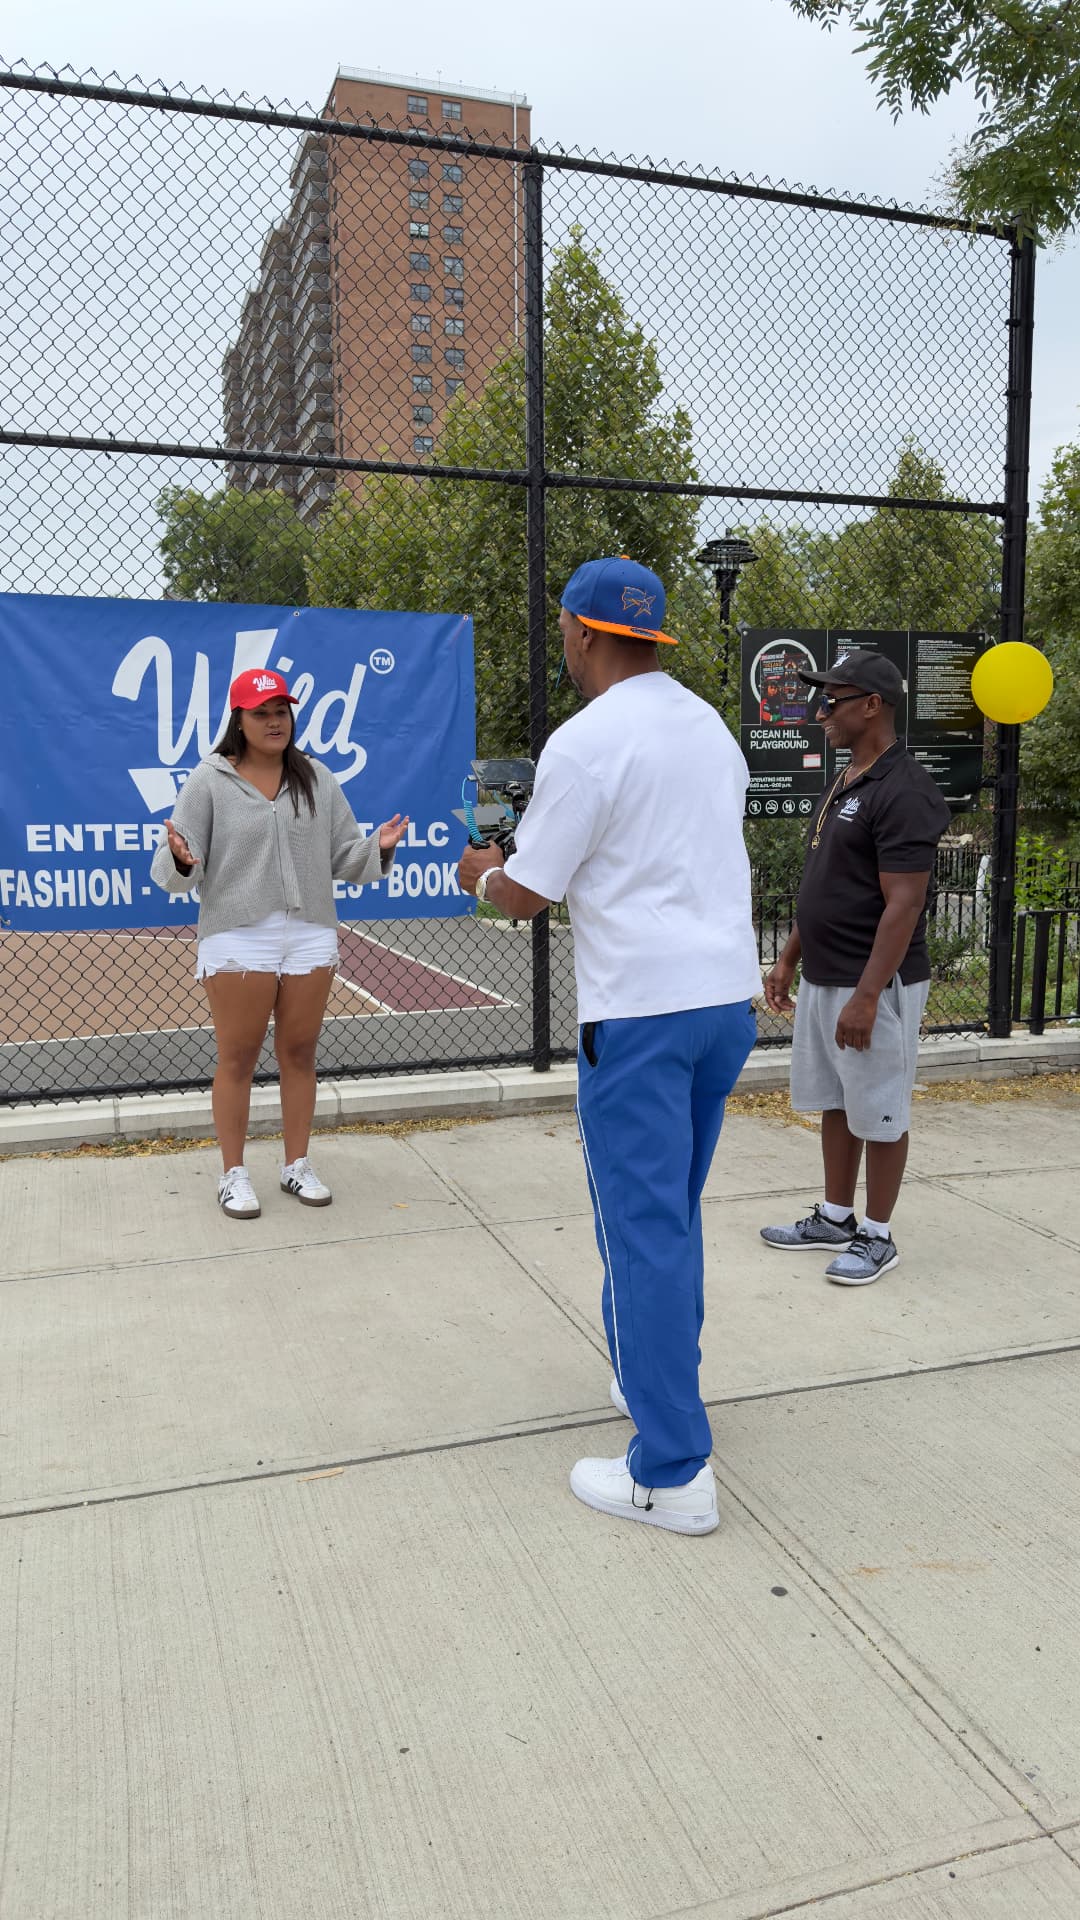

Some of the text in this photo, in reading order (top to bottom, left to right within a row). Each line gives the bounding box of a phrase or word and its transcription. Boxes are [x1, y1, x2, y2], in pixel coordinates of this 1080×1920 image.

[373, 656, 391, 666] TM
[252, 674, 277, 690] Wild
[112, 629, 367, 785] Wld
[750, 729, 802, 739] OCEAN HILL
[750, 740, 809, 750] PLAYGROUND
[395, 822, 449, 847] LC
[0, 868, 133, 908] FASHION
[388, 862, 470, 898] BOOK
